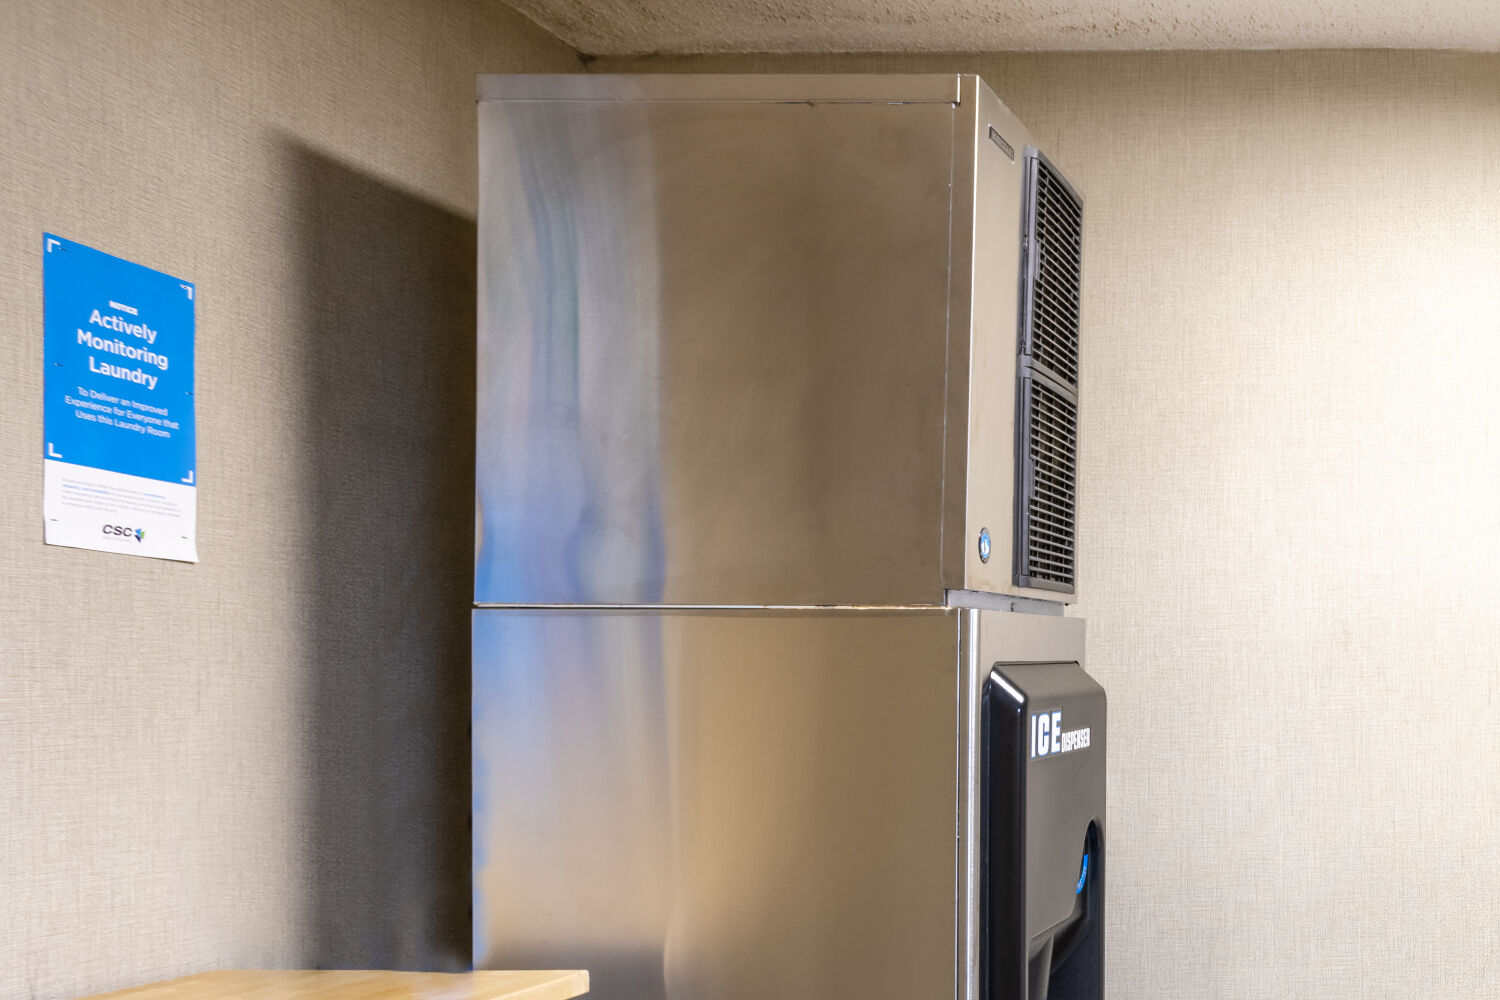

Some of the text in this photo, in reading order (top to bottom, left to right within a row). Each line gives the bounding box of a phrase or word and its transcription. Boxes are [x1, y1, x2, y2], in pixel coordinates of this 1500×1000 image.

[89, 309, 157, 344] Actively
[77, 329, 168, 371] Monitoring
[89, 356, 158, 390] Laundry
[64, 395, 179, 430] Experience for Everyone that
[77, 386, 168, 416] To Deliver an Improved
[75, 409, 171, 438] Uses this Laundry Room
[102, 524, 133, 537] CSC
[1031, 710, 1091, 759] ICE DISPENSER
